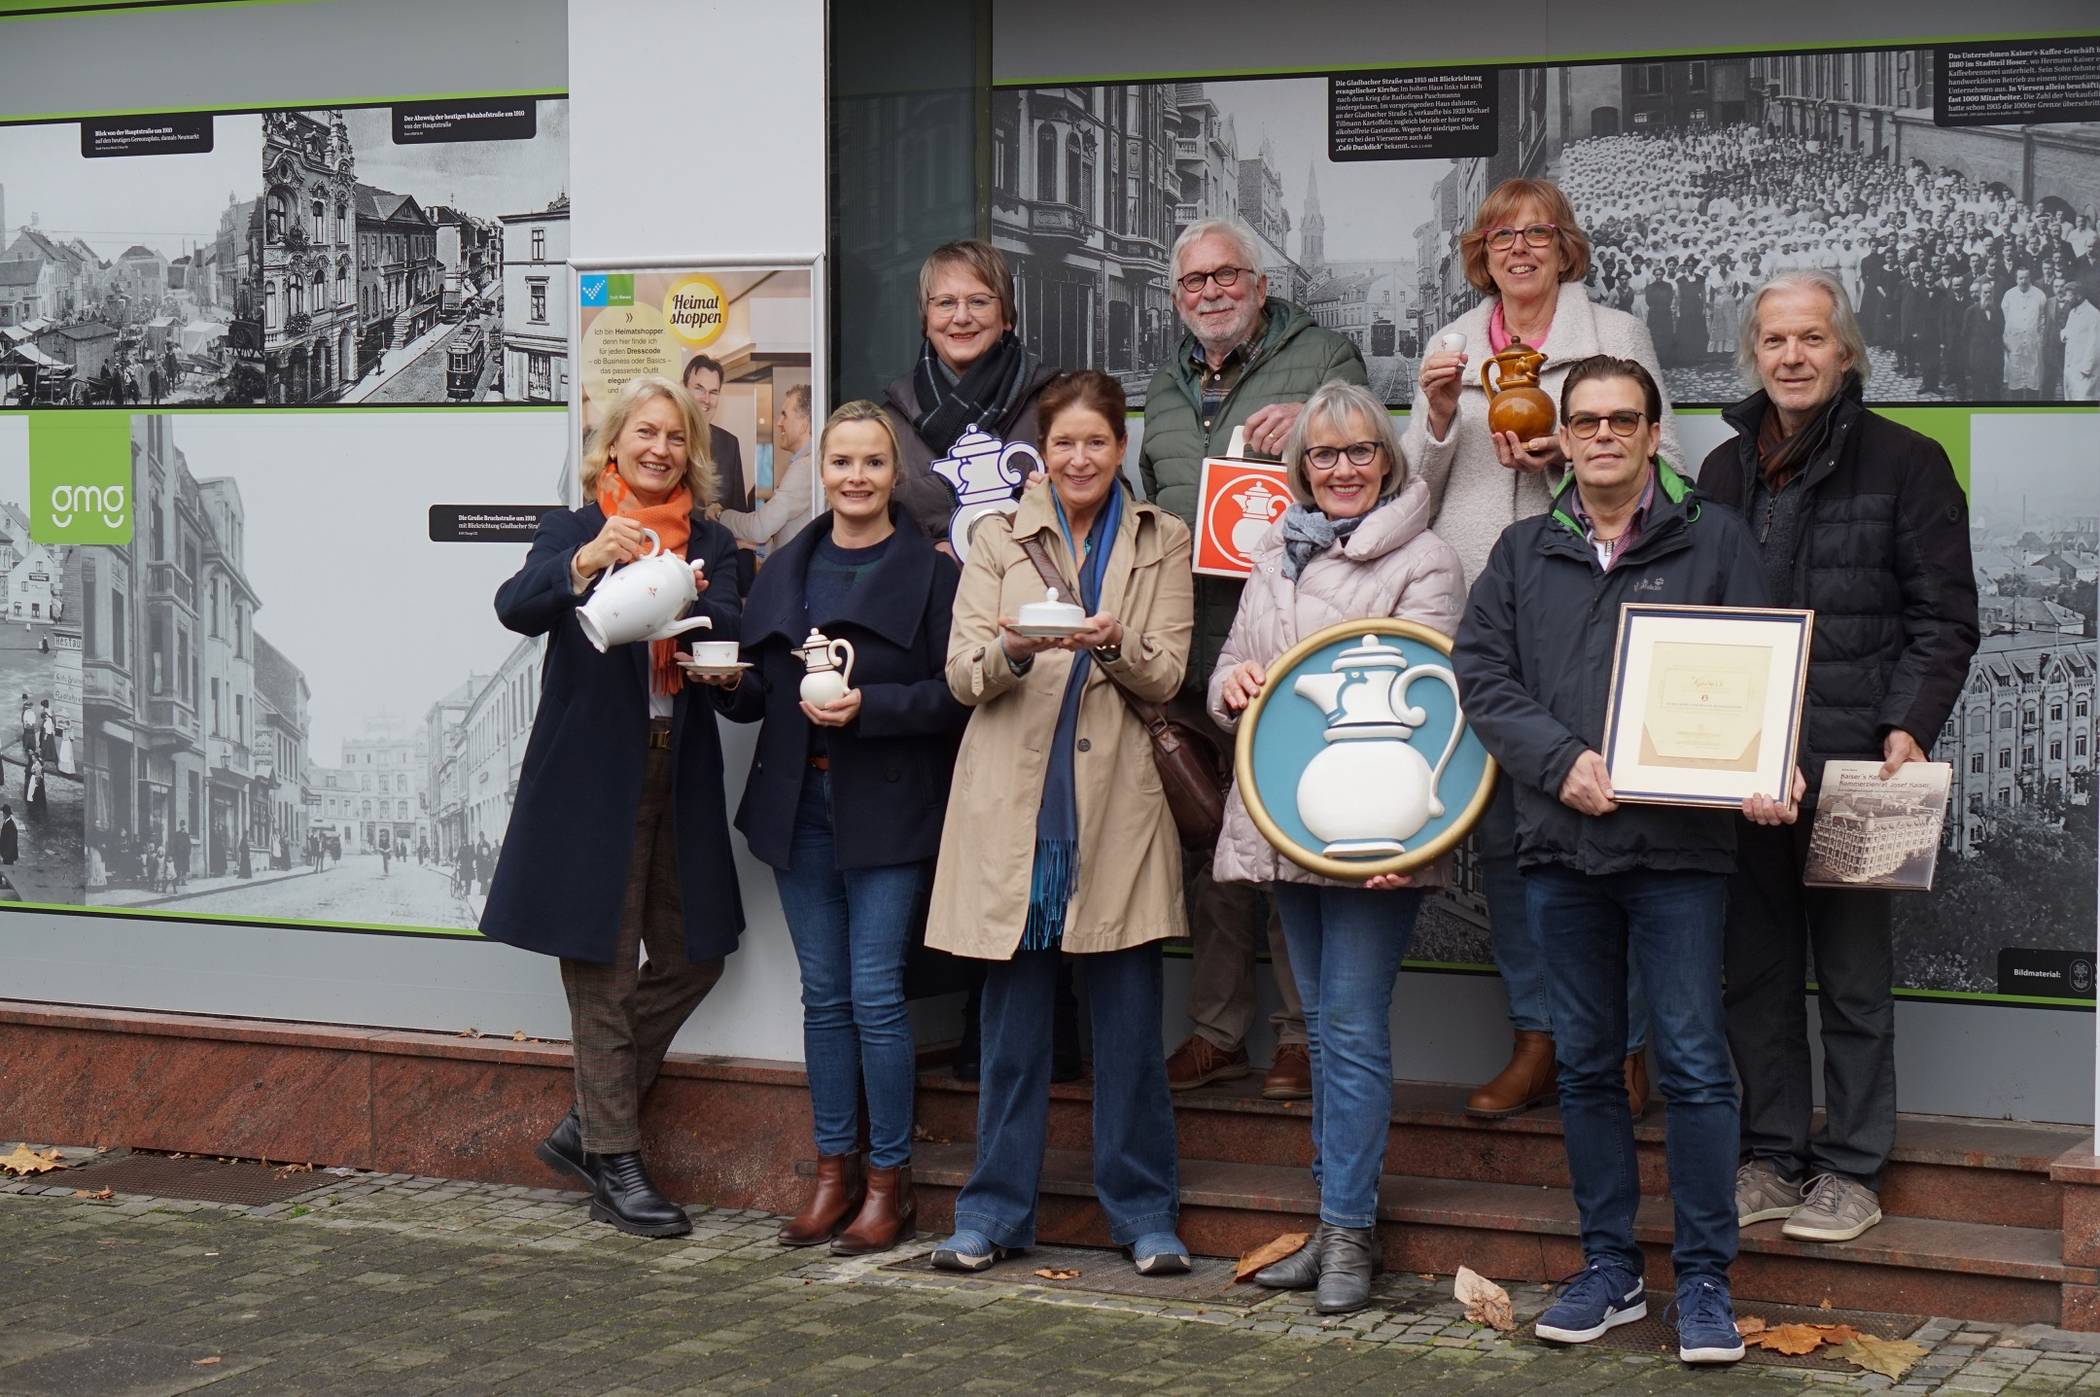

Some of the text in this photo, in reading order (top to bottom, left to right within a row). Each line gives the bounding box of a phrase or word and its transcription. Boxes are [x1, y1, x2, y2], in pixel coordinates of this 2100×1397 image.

[1440, 75, 1482, 84] Blickrichtung
[1336, 87, 1376, 96] evangelischer
[672, 294, 719, 310] Heimat
[670, 310, 721, 328] shoppen
[51, 485, 124, 528] gmg
[2014, 968, 2061, 978] Bildmaterial:
